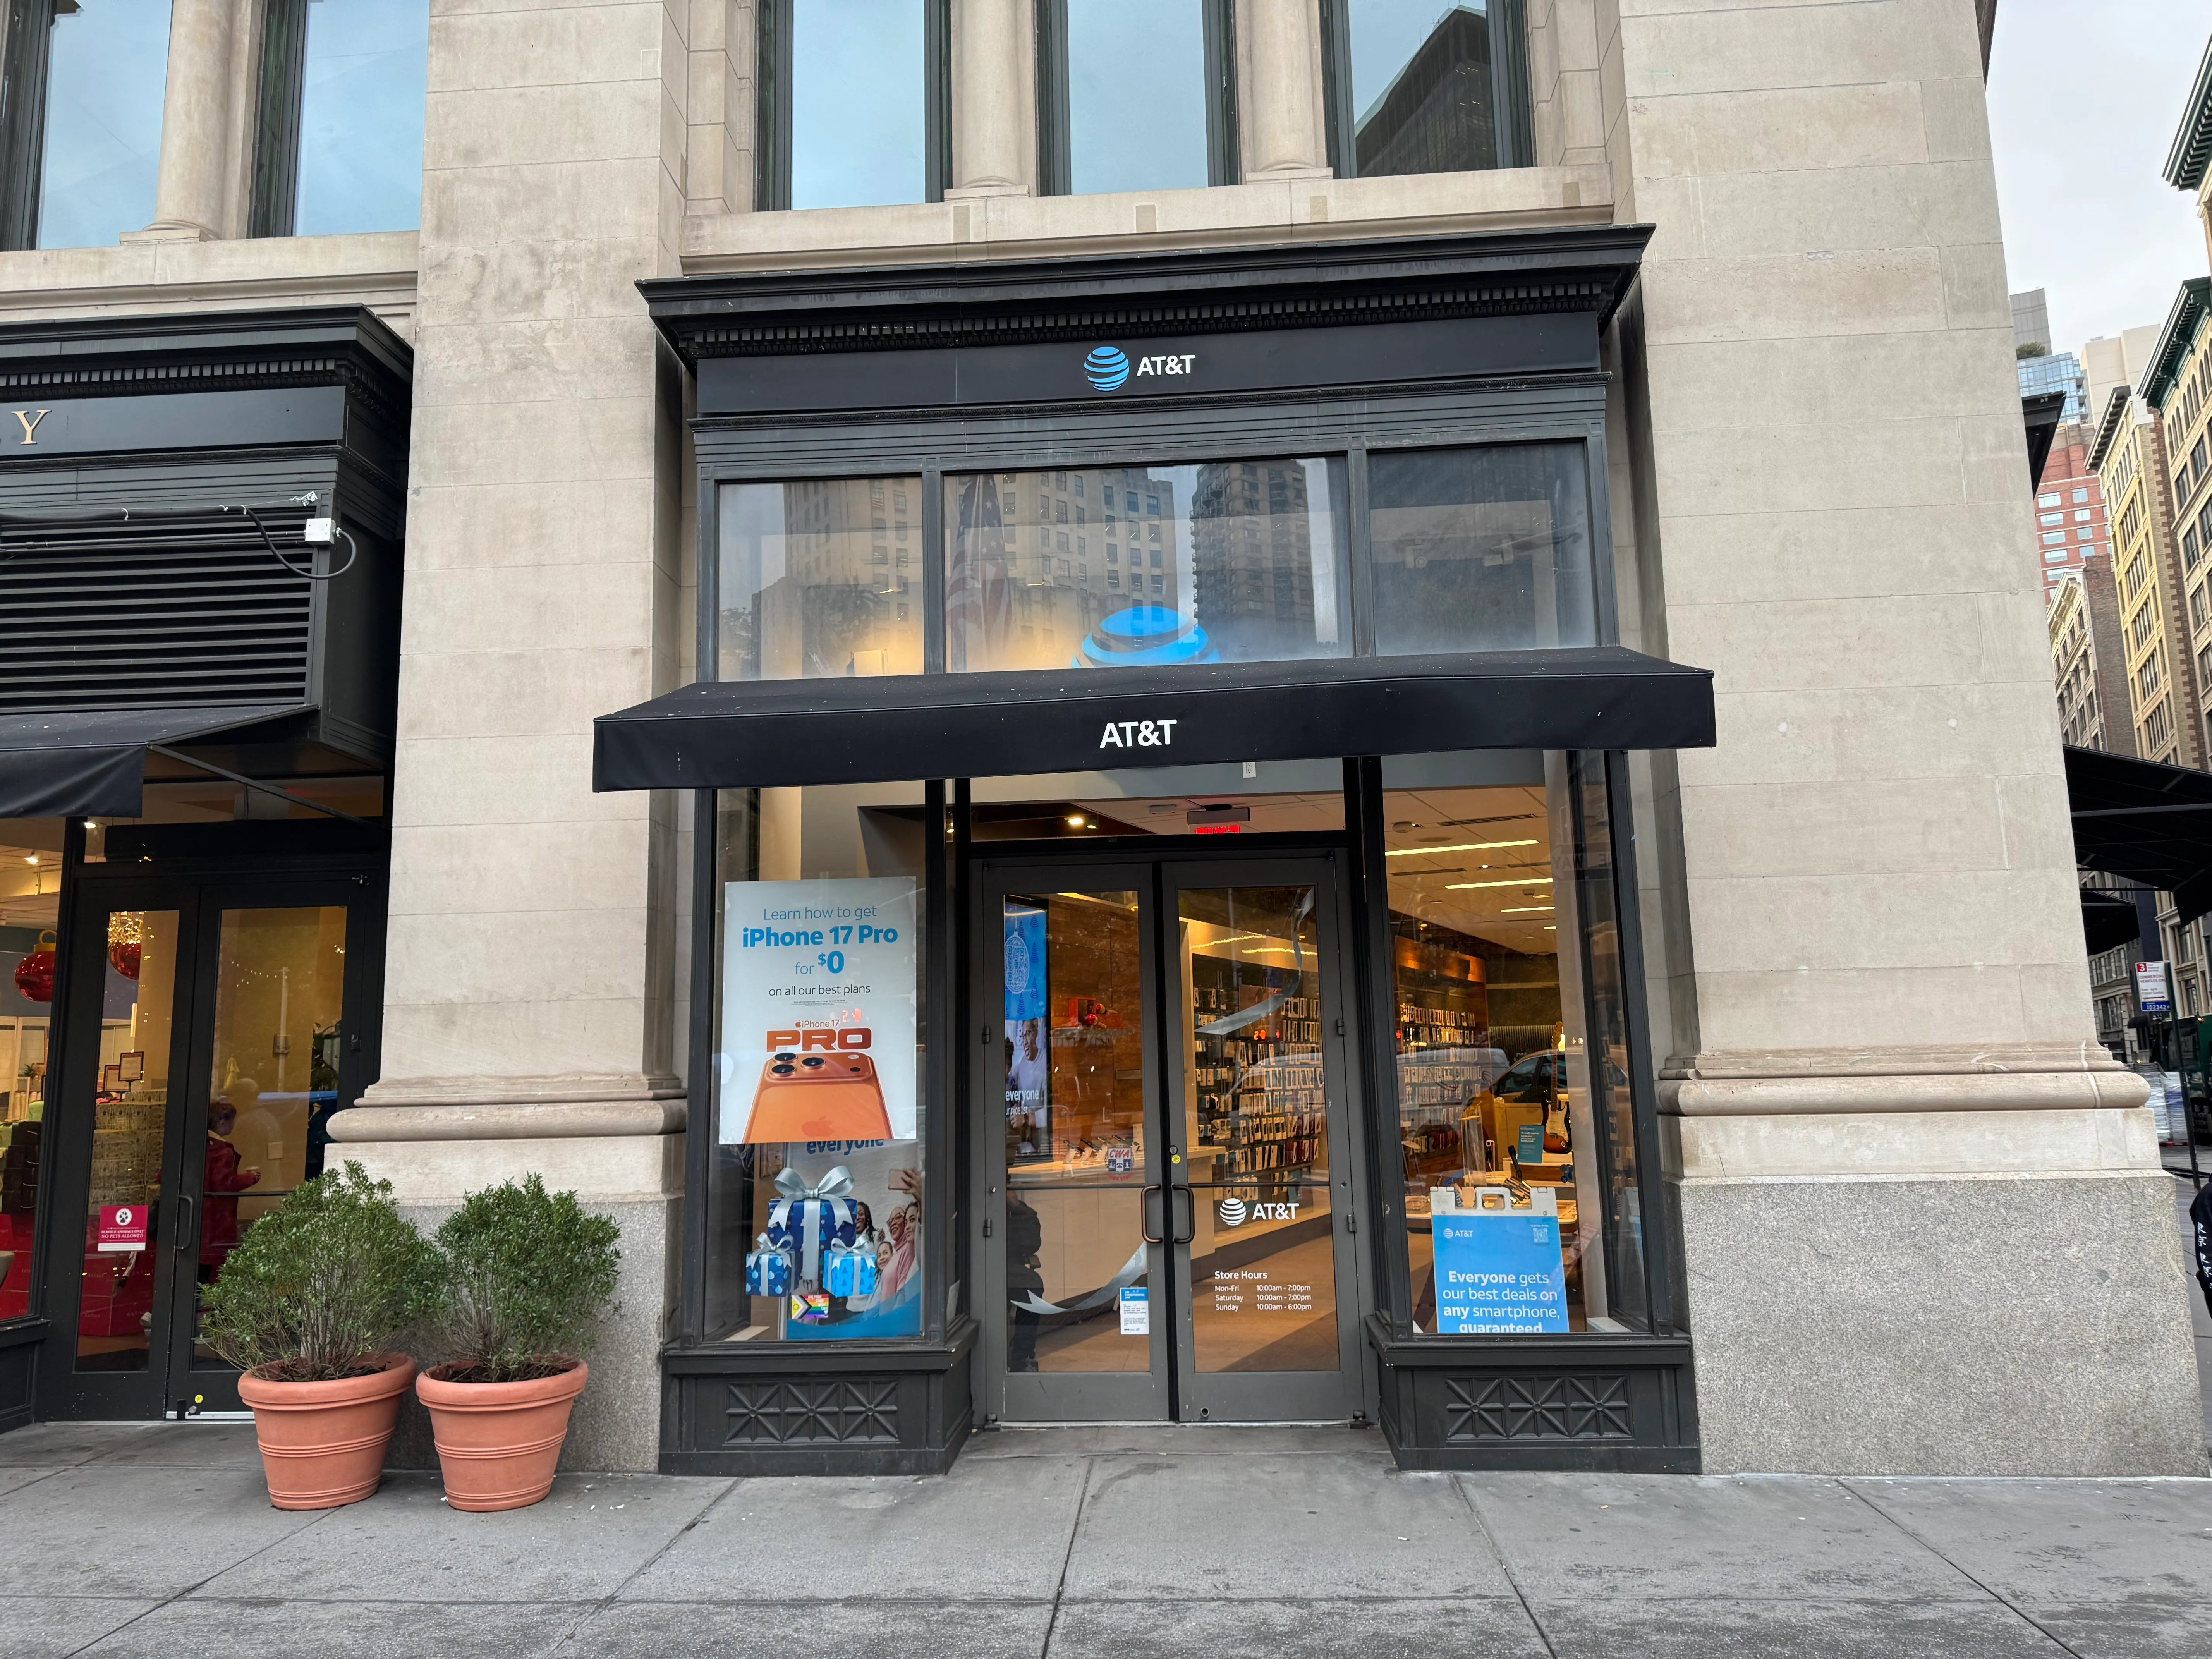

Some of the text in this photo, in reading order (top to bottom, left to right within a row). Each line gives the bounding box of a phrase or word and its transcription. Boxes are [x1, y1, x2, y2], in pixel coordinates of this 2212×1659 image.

[1137, 355, 1195, 376] AT&T
[1099, 719, 1177, 748] AT&T
[764, 905, 877, 921] Learn how to get
[742, 925, 898, 948] iPhone 17 Pro
[795, 950, 844, 975] for $0
[769, 984, 871, 996] on all our best plans
[802, 1020, 830, 1029] iPhone
[766, 1028, 872, 1052] PRO
[1005, 1090, 1039, 1104] everyone
[1109, 1149, 1130, 1158] CWA
[1252, 1202, 1299, 1220] AT&T
[1214, 1271, 1267, 1279] Store Hours
[1448, 1271, 1549, 1286] Everyone gets
[1288, 1285, 1311, 1293] 7:00pm
[1443, 1288, 1558, 1301] our best deals on
[1288, 1294, 1311, 1302] 7:00pm
[1444, 1305, 1560, 1320] any smartphone,
